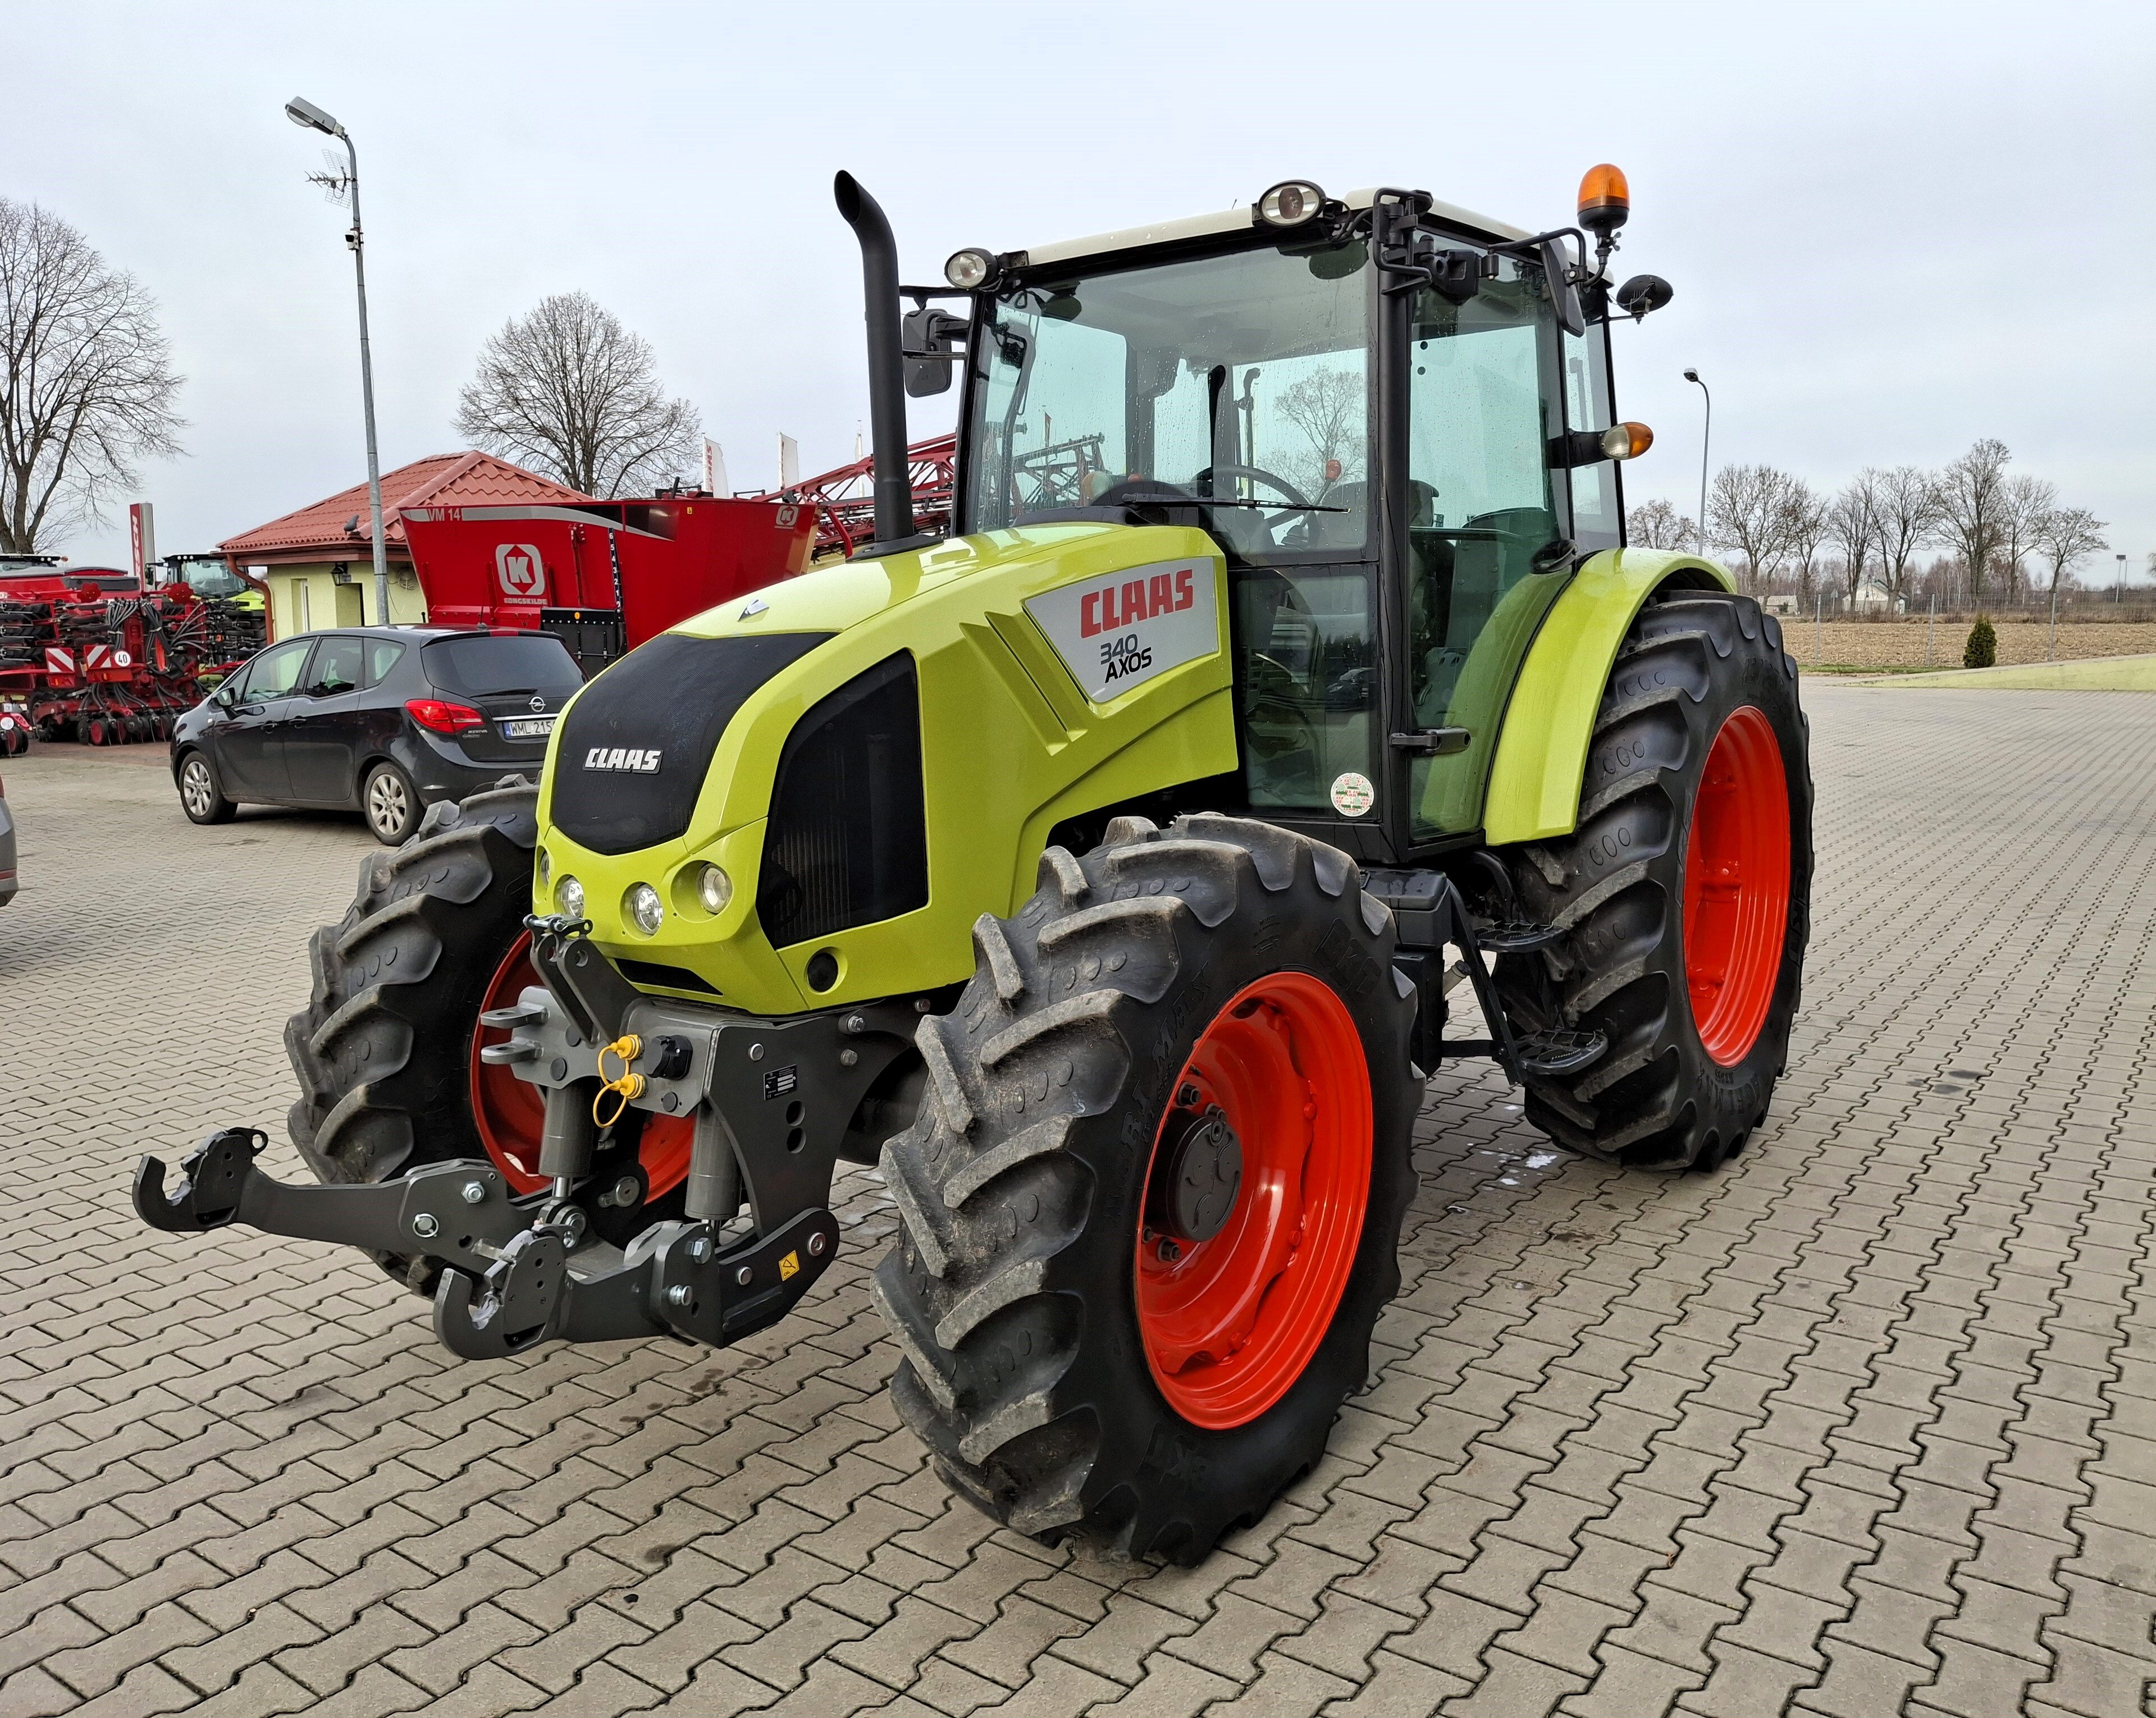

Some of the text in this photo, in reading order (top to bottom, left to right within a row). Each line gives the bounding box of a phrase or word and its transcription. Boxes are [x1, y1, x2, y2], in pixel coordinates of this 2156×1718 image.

[427, 508, 460, 522] VM 14
[1081, 569, 1193, 639] CLAAS
[118, 654, 127, 664] 40
[1100, 634, 1138, 665] 340
[1105, 647, 1152, 684] AXOS
[510, 723, 531, 735] WML
[584, 748, 661, 771] CLAAS
